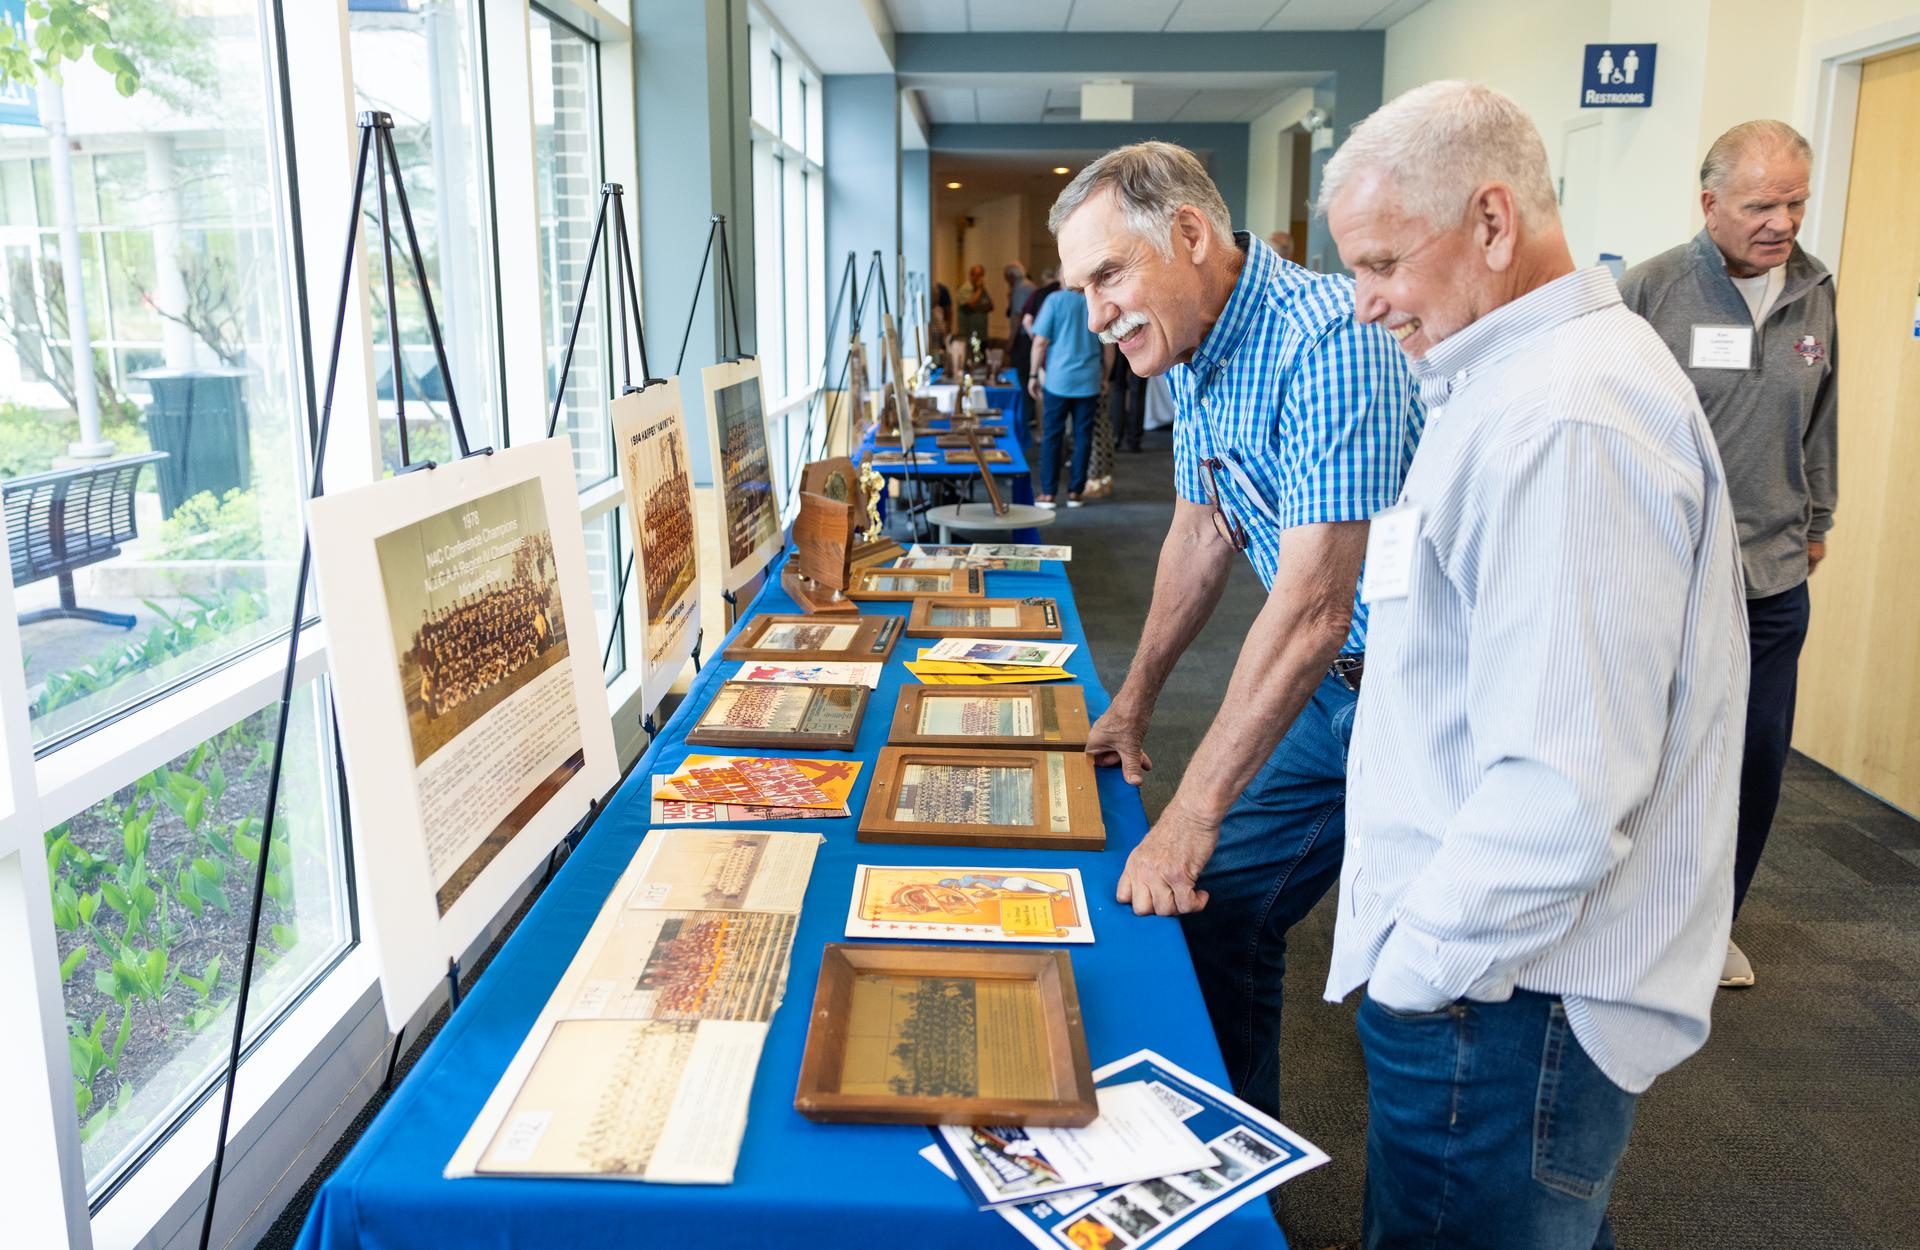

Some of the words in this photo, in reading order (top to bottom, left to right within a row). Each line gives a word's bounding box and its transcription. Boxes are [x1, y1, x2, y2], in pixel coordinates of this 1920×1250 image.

[1585, 89, 1646, 104] RESTROOMS
[444, 534, 482, 561] Conference
[482, 519, 519, 543] Champions
